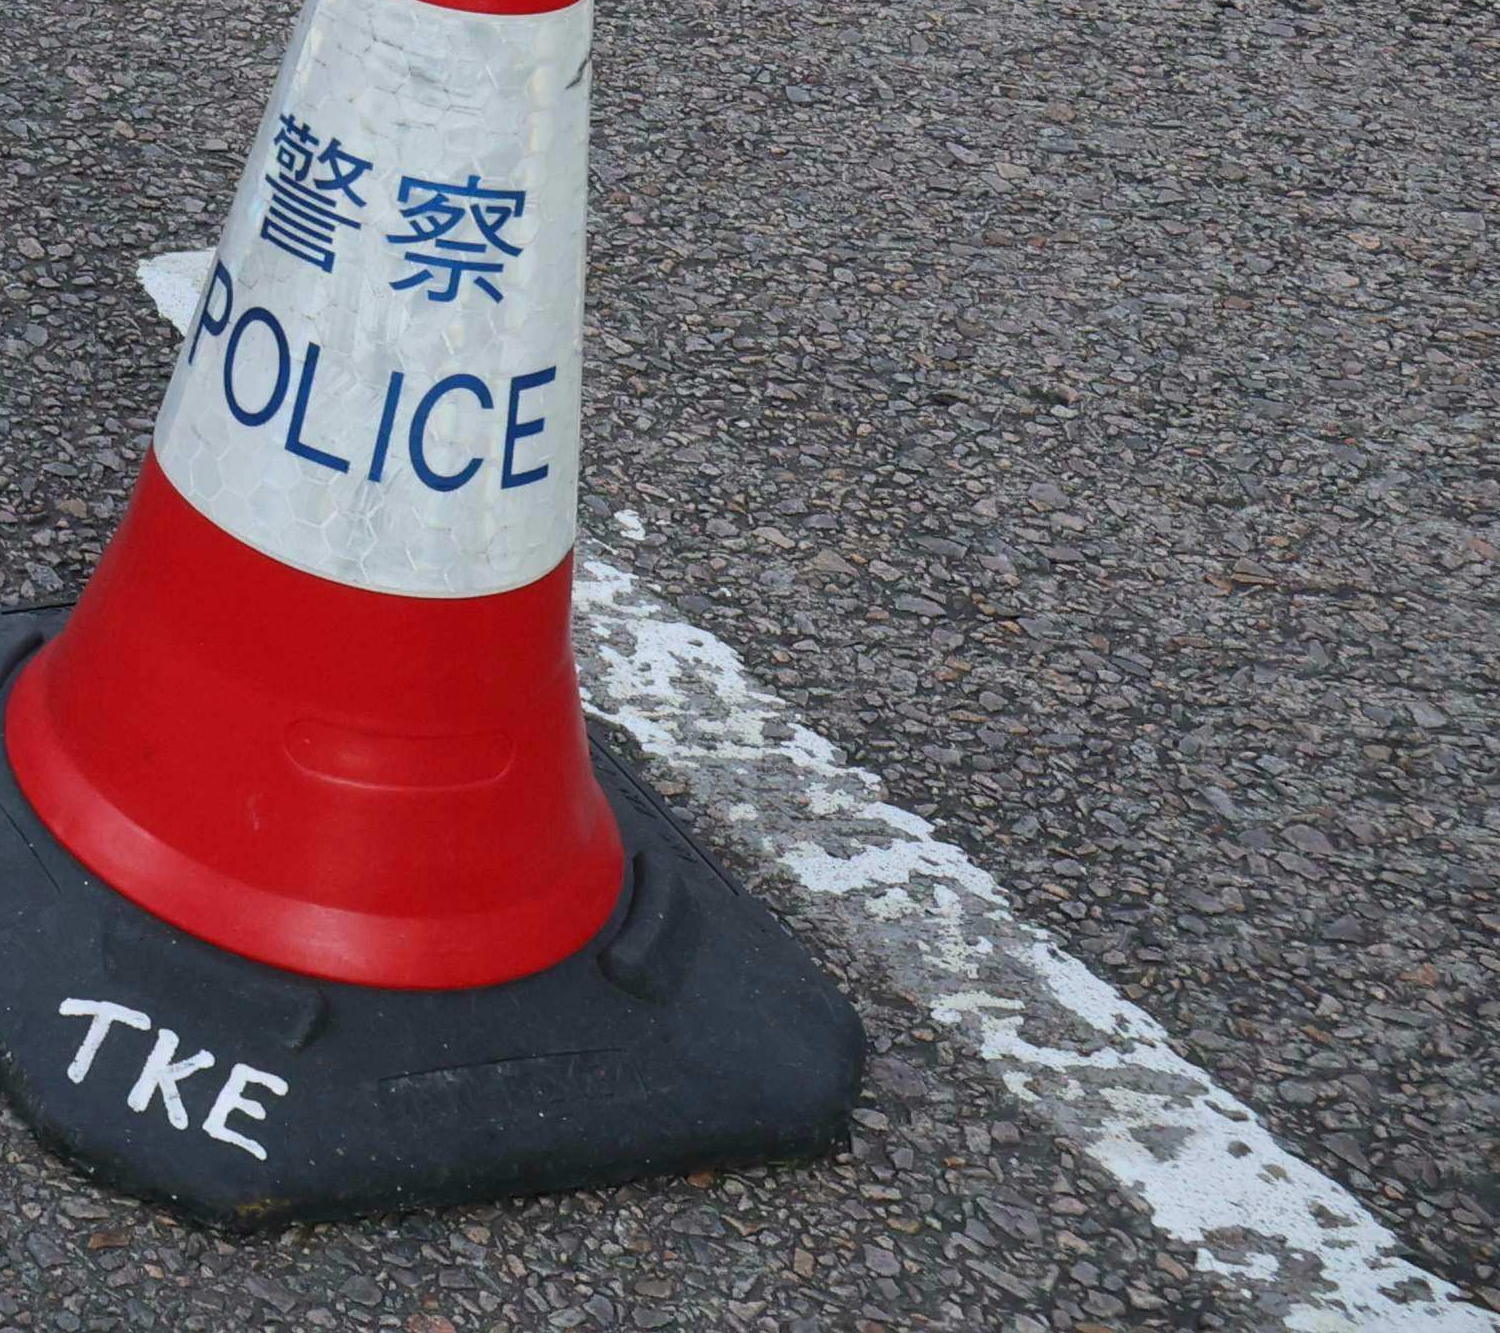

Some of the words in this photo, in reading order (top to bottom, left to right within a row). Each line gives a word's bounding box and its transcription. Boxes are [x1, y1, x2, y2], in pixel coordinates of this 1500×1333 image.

[258, 112, 528, 305] 警察
[188, 257, 558, 495] POLICE
[57, 996, 291, 1161] TKE
